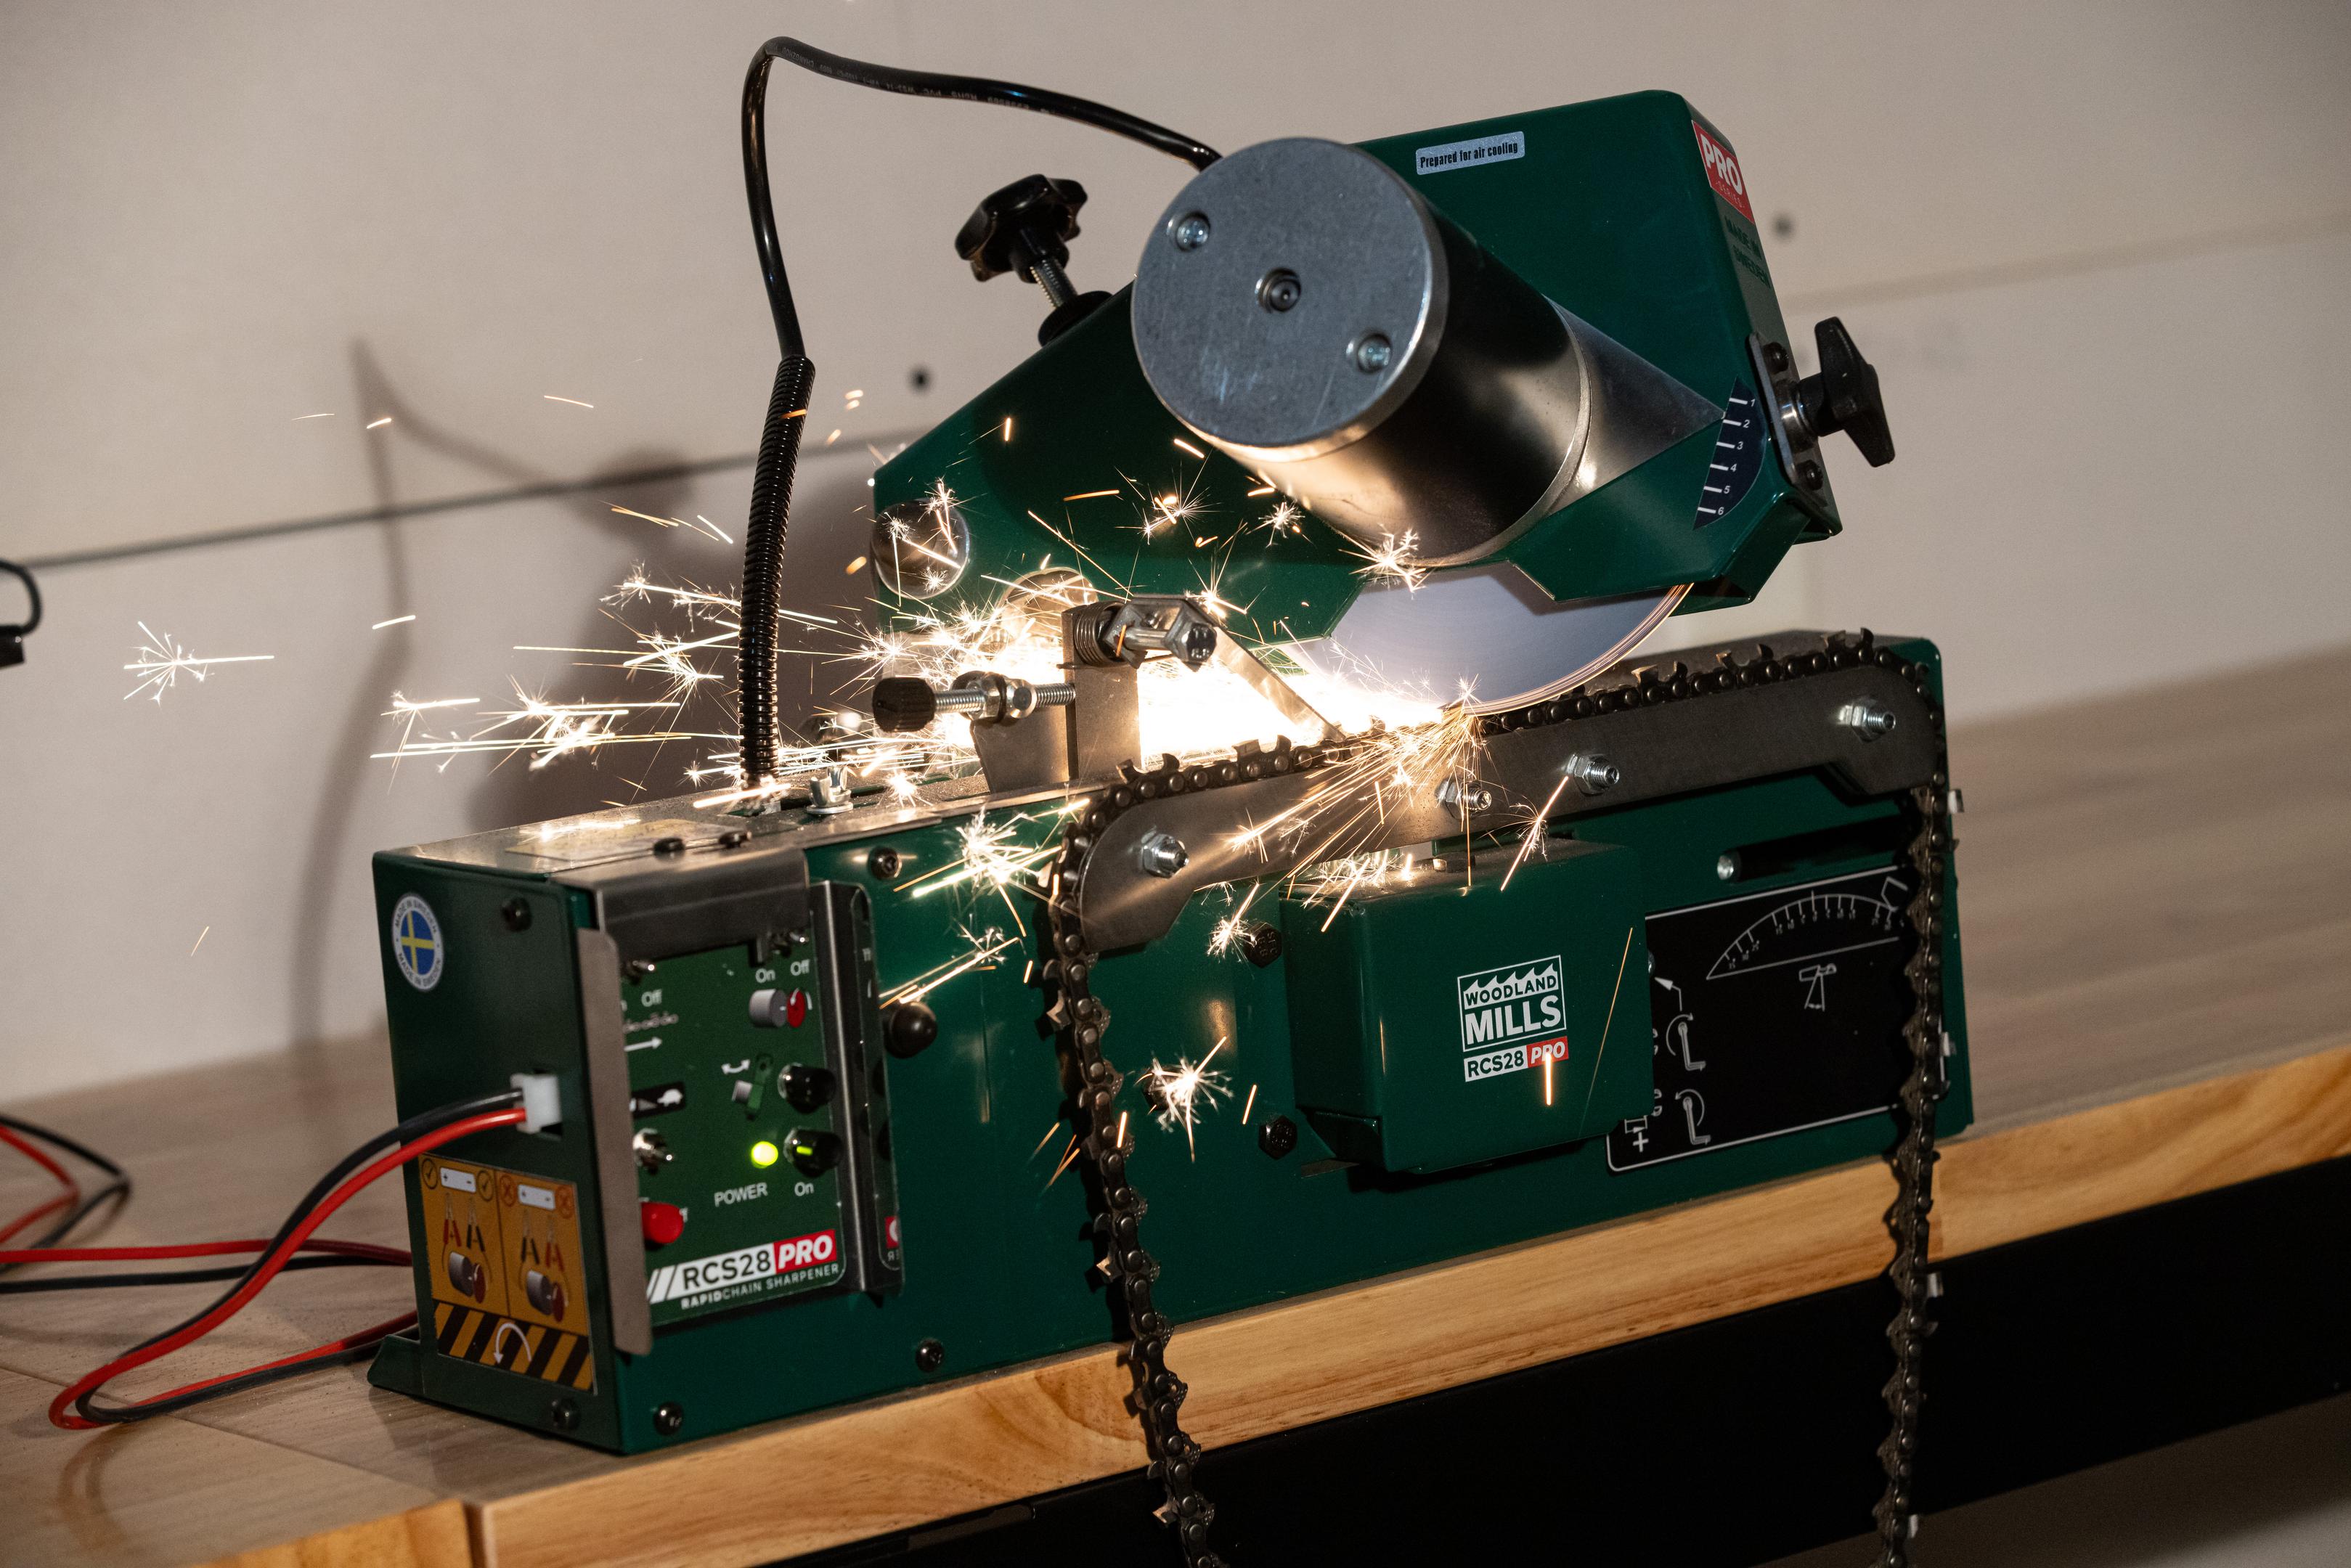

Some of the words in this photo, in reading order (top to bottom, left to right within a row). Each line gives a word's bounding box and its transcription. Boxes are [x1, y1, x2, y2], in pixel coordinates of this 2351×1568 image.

[1419, 151, 1458, 168] Prepared
[1459, 150, 1472, 162] for
[1473, 147, 1486, 159] air
[1487, 142, 1519, 157] cooling
[1700, 133, 1743, 195] PRO
[1751, 399, 1756, 407] 1
[1743, 419, 1751, 429] 2
[1736, 441, 1744, 450] 3
[1729, 463, 1737, 473] 4
[1723, 485, 1731, 494] 5
[1717, 507, 1725, 516] 6
[755, 968, 776, 984] On
[790, 958, 811, 976] Off
[641, 989, 663, 1008] Off
[1465, 974, 1557, 1006] WOODLAND
[1464, 995, 1562, 1045] MILLS
[1467, 1050, 1525, 1078] RCS28
[1530, 1040, 1566, 1065] PRO
[713, 1181, 769, 1208] POWER
[794, 1181, 815, 1197] On
[683, 1249, 772, 1291] RCS28
[777, 1234, 834, 1270] PRO
[680, 1281, 762, 1310] RAPIDCHAIN
[765, 1262, 840, 1291] SHARPENER
